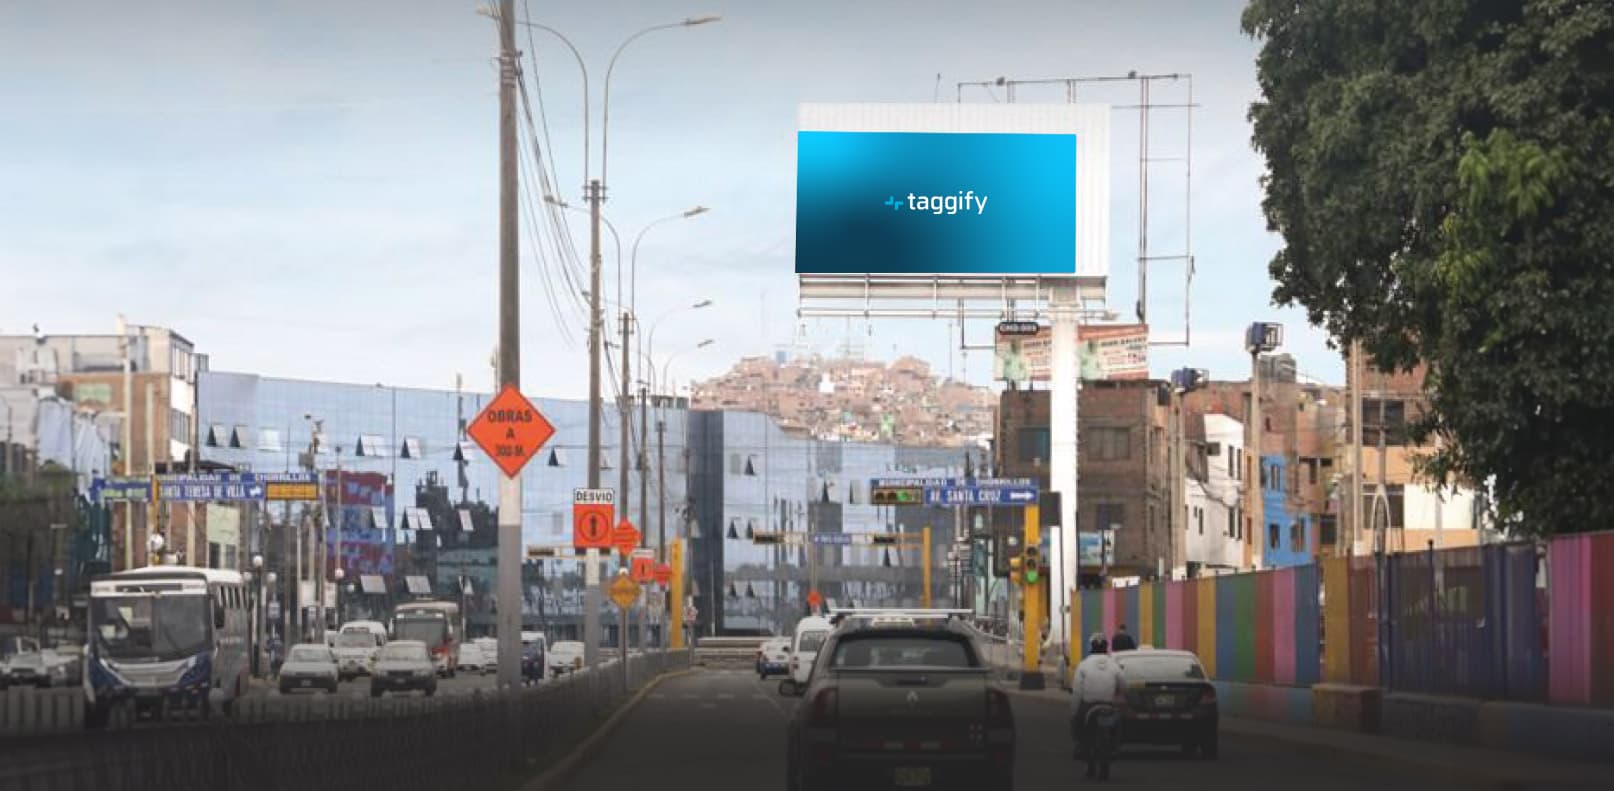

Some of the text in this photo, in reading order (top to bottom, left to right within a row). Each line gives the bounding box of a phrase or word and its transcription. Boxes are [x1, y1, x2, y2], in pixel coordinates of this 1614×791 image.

[907, 190, 988, 215] taggify
[488, 410, 532, 423] OBRAS
[506, 427, 515, 439] A
[576, 491, 612, 501] DESVIO
[947, 489, 975, 502] SANTA
[978, 489, 1001, 502] CRUZ
